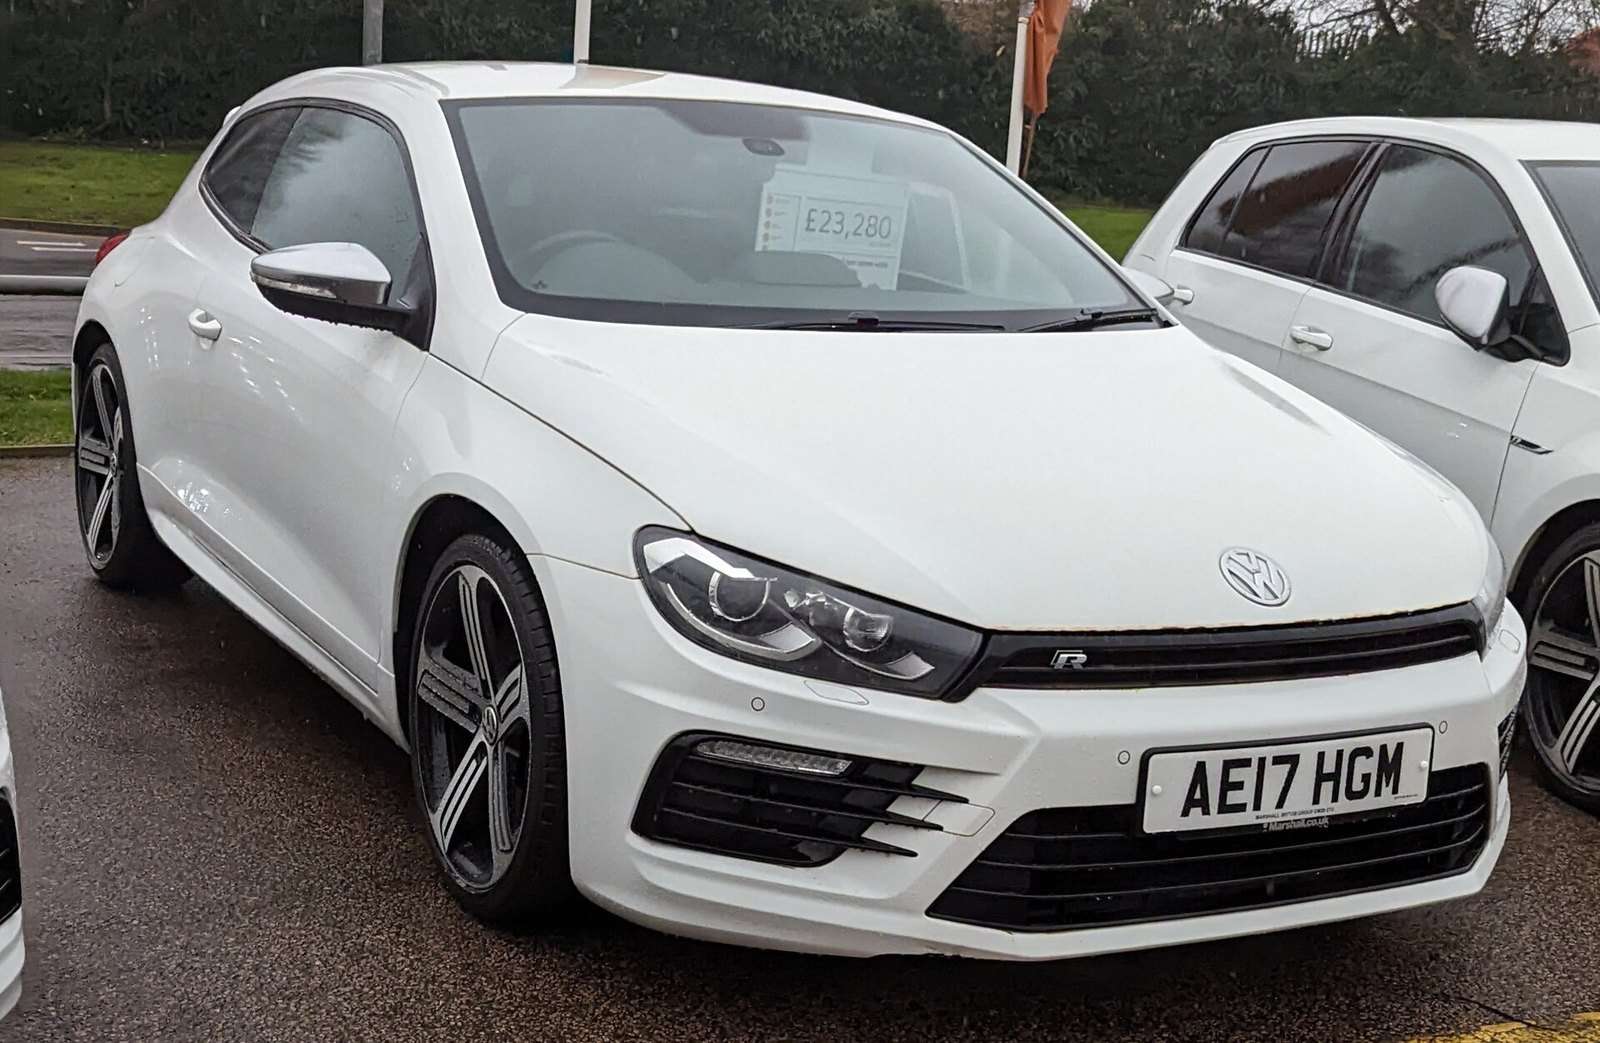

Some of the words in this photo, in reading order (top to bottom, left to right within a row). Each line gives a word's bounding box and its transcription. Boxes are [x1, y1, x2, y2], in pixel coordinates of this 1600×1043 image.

[805, 208, 892, 240] £23,280
[1050, 649, 1087, 669] R
[1180, 753, 1300, 818] AE17
[1312, 741, 1404, 806] HGM
